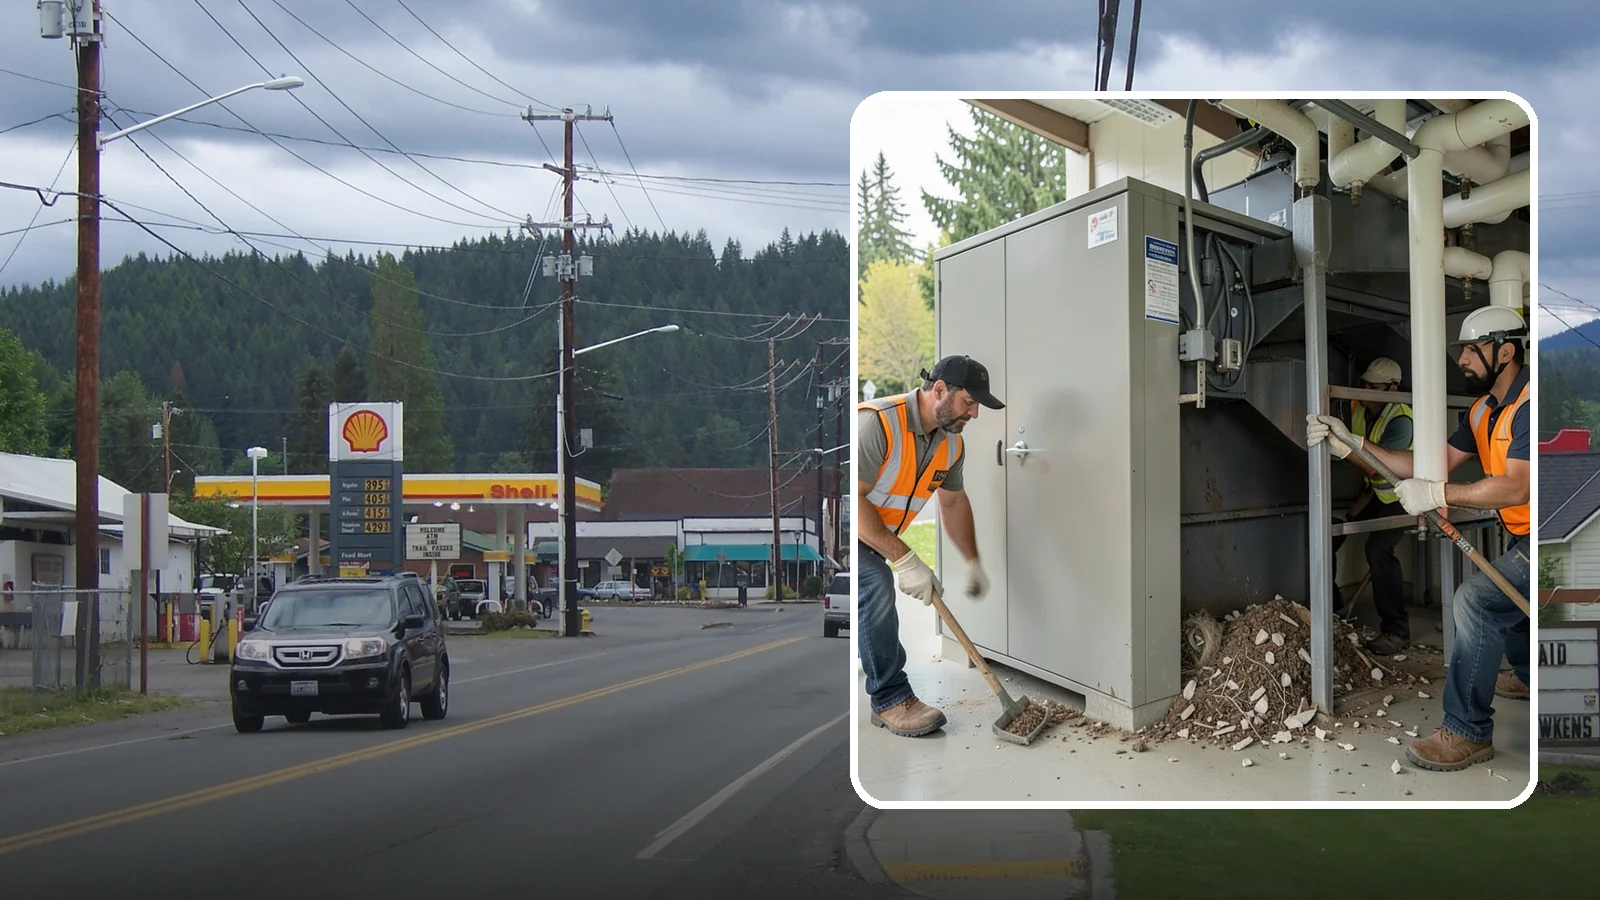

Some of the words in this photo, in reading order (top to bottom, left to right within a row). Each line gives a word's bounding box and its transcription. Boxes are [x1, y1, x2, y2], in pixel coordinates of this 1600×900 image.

[365, 480, 384, 490] 395
[490, 484, 547, 499] Shell
[365, 494, 384, 504] 405
[365, 508, 384, 518] 415
[365, 522, 384, 533] 429
